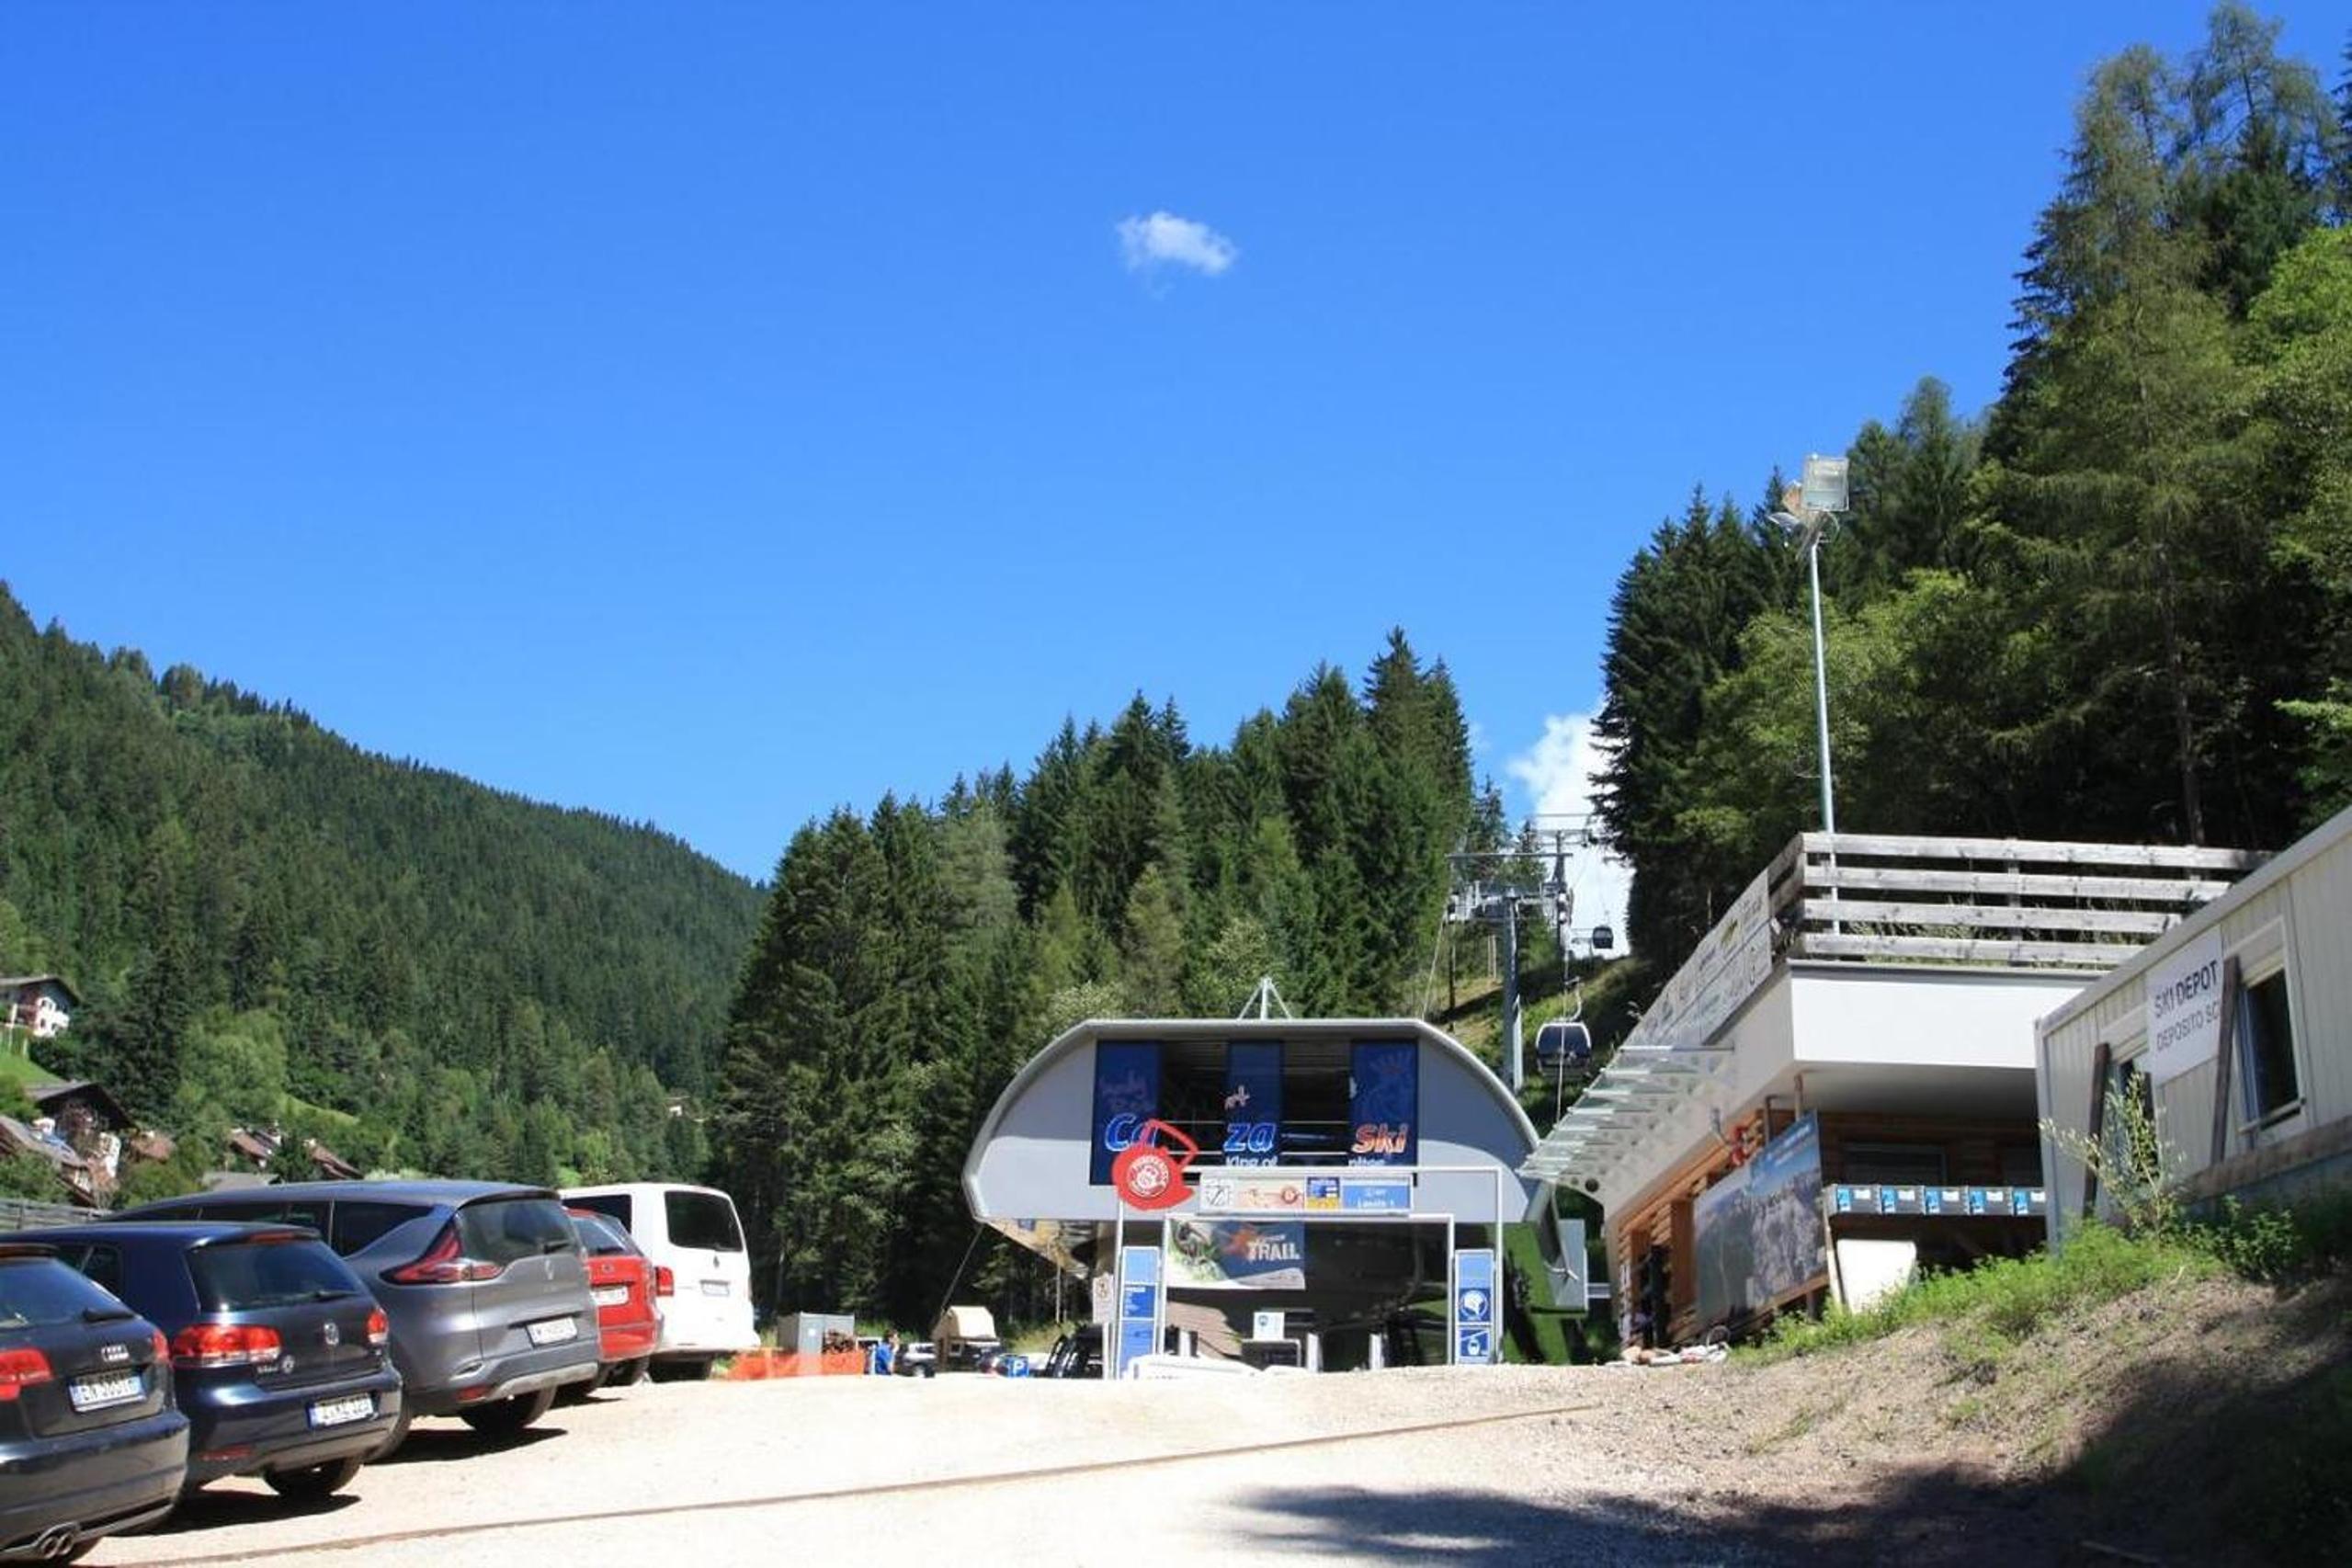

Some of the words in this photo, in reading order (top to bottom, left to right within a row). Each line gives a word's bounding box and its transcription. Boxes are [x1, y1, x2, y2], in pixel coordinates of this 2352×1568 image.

[2154, 986, 2175, 1018] SKI
[2176, 960, 2218, 1006] DEPOT
[2156, 1010, 2204, 1051] DEPOSITO
[1223, 1122, 1277, 1153] za
[1350, 1122, 1409, 1153] Ski
[1247, 1240, 1301, 1262] TRAIL
[1013, 1360, 1026, 1376] P
